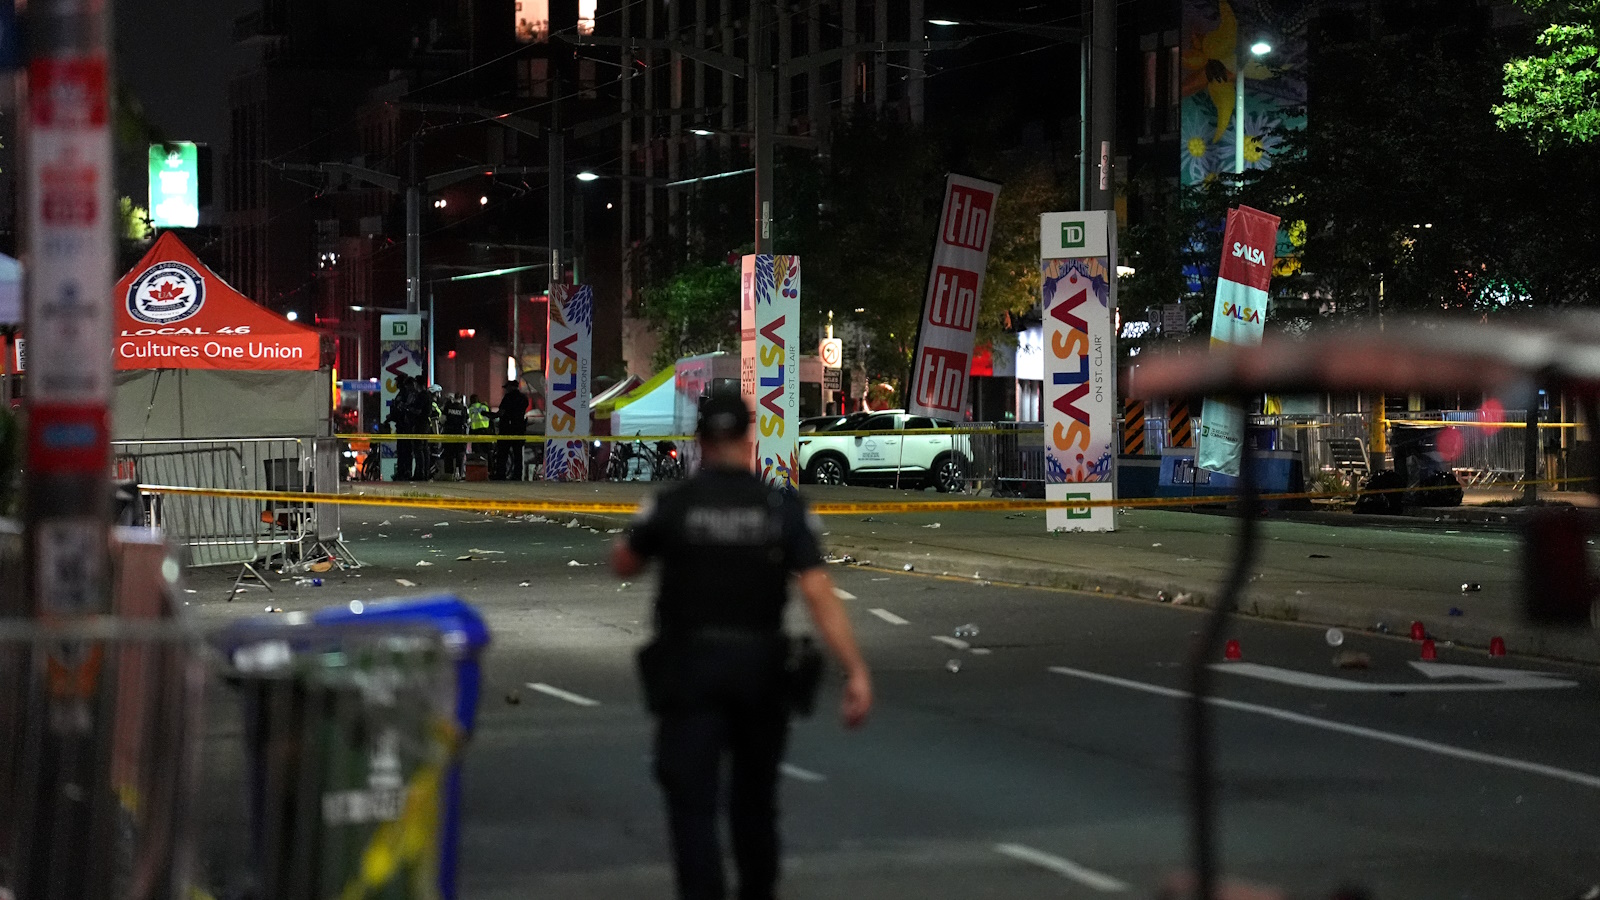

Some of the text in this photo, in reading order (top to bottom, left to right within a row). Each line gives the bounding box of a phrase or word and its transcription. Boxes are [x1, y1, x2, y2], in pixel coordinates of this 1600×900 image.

[946, 192, 986, 248] tln
[1063, 225, 1083, 244] TD
[1232, 241, 1266, 267] SALSA
[932, 273, 973, 328] tln
[1222, 301, 1260, 324] SALSA
[120, 325, 251, 337] LOCAL 46
[394, 323, 406, 334] TD
[120, 341, 200, 358] Cultures
[204, 342, 244, 358] One
[248, 341, 303, 358] Union
[759, 315, 785, 438] SALSA
[919, 354, 960, 409] tln
[1050, 288, 1091, 452] SALSA
[1095, 370, 1103, 383] ST.
[552, 333, 578, 433] SALSA
[580, 358, 588, 409] IN TORONTO
[1095, 386, 1103, 403] ON
[788, 392, 795, 408] ON
[448, 408, 462, 416] POLICE
